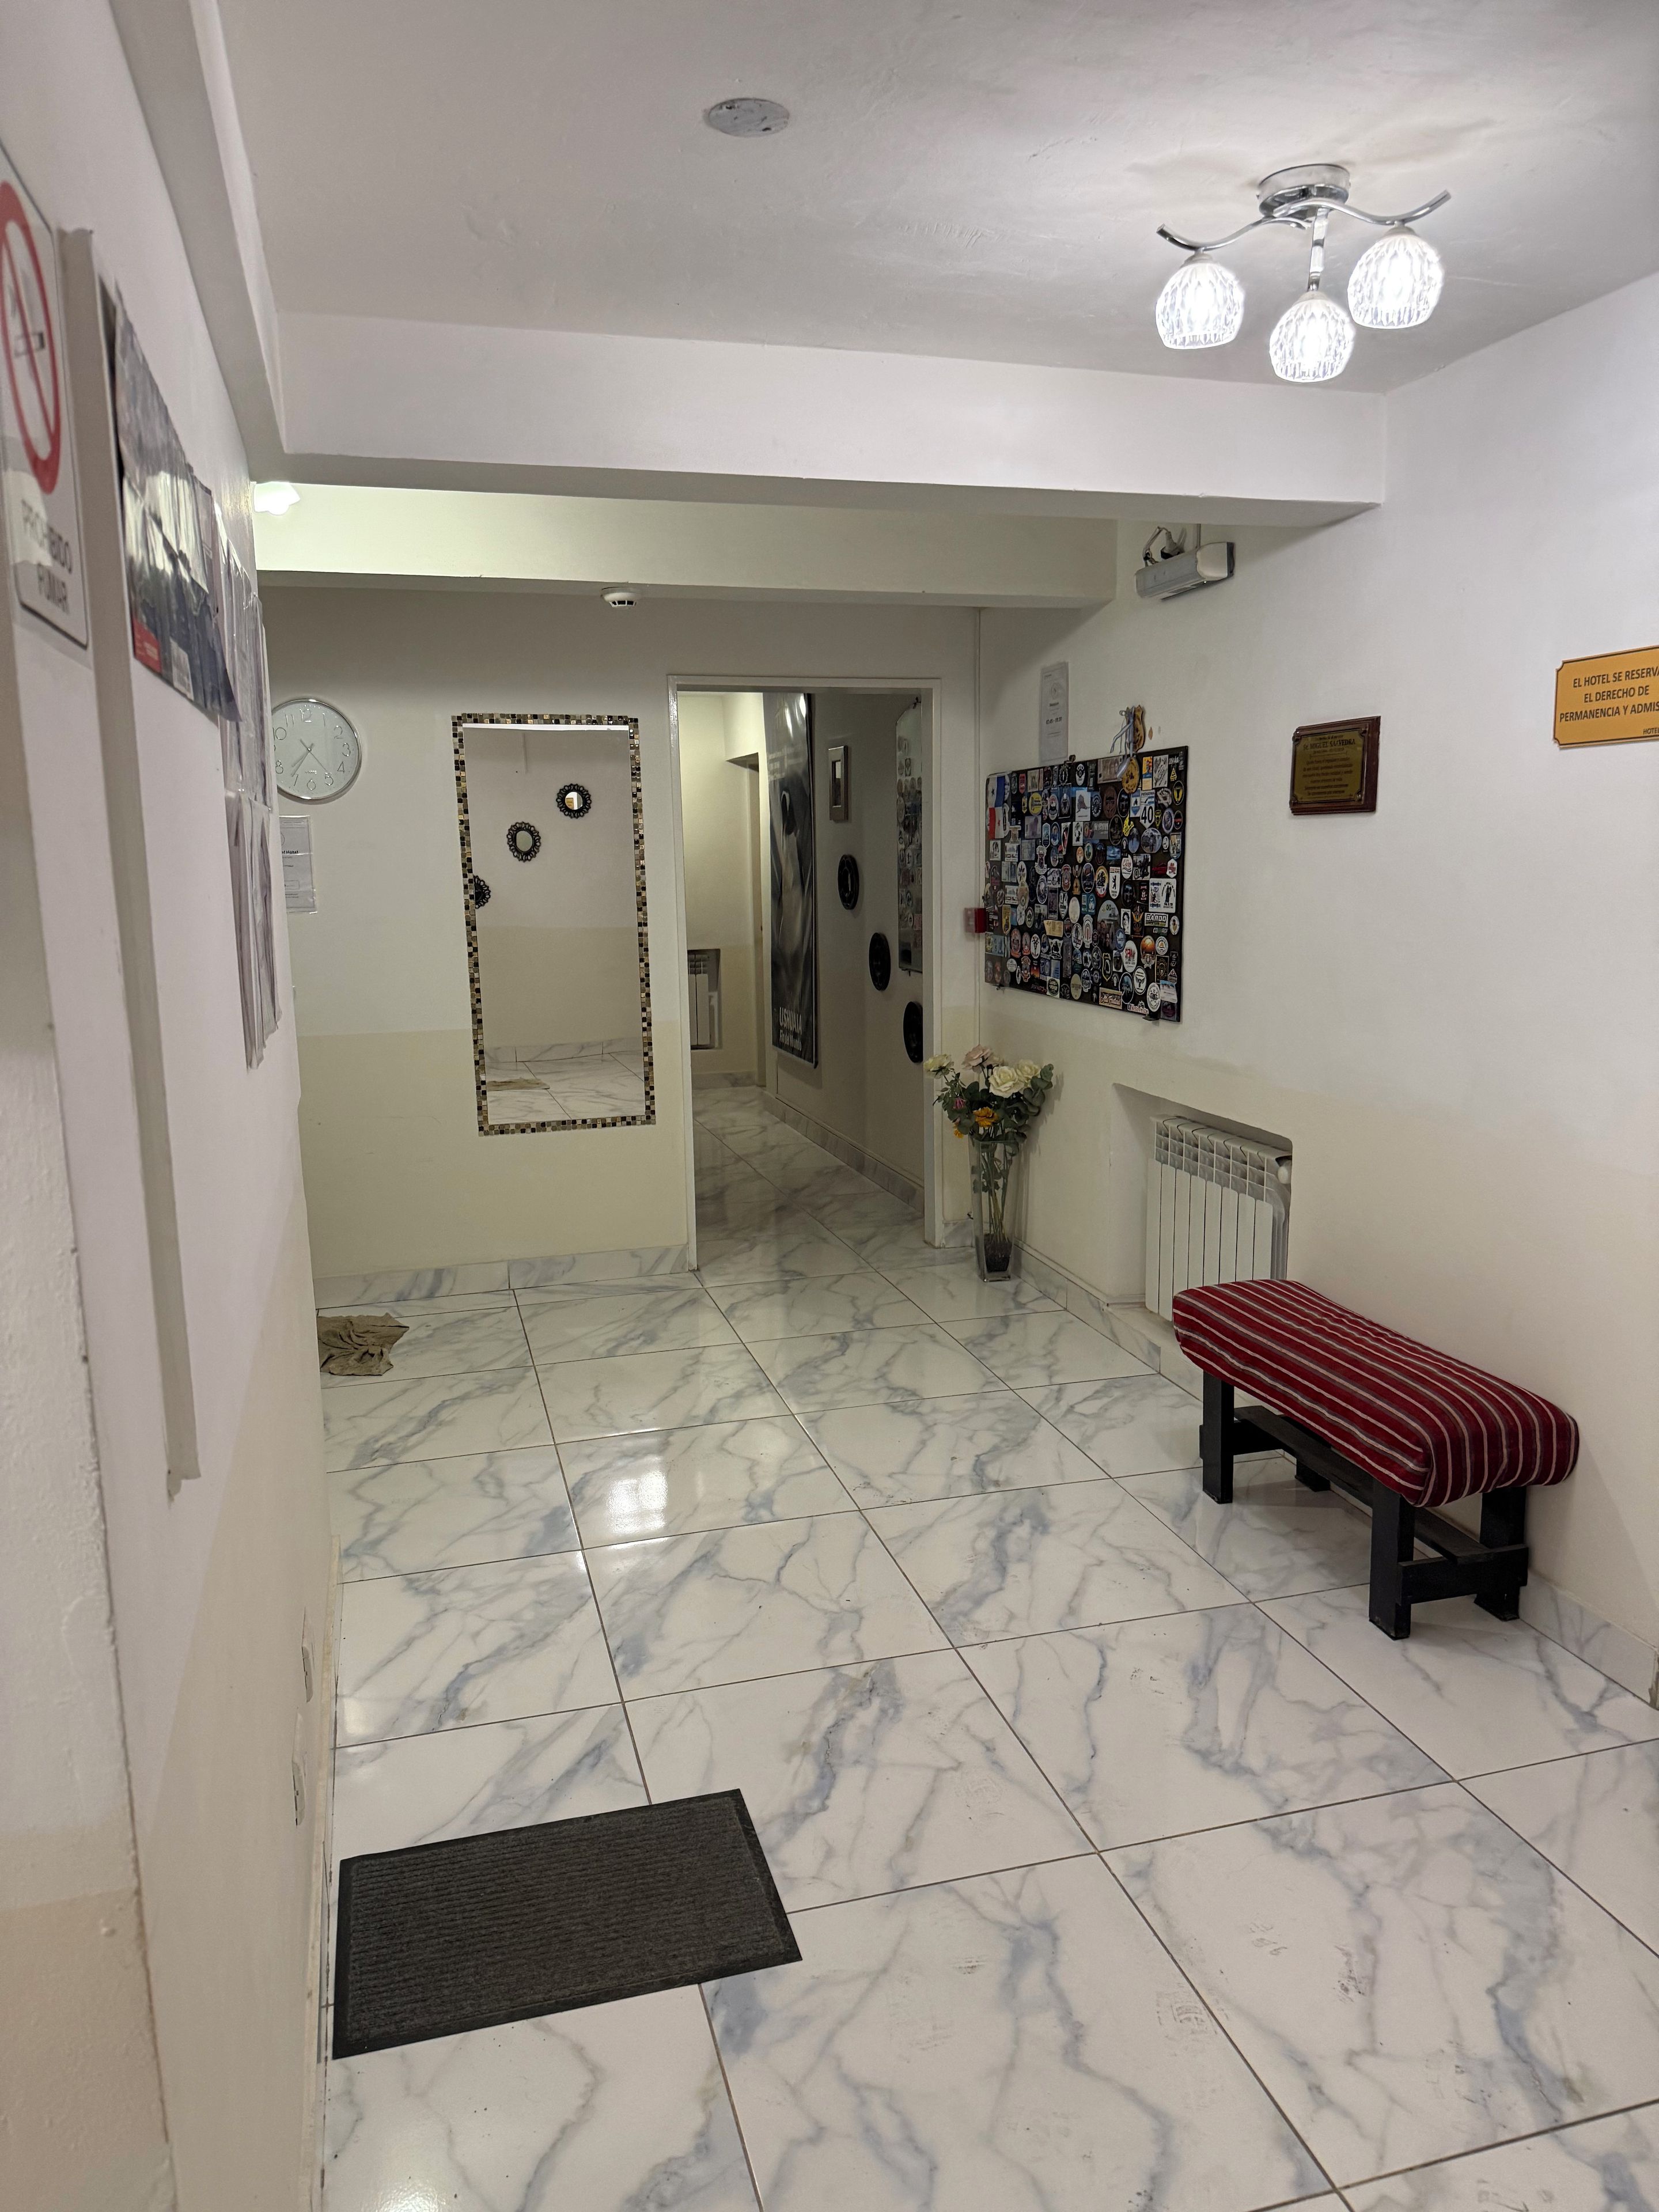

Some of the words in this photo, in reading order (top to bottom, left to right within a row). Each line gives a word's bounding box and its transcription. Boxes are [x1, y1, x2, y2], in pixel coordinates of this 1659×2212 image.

[1573, 678, 1582, 688] EL
[1584, 674, 1610, 686] HOTEL
[1612, 672, 1622, 683] SE
[1584, 693, 1593, 703] EL
[1595, 687, 1635, 701] DERECHO
[1638, 685, 1649, 696] DE
[300, 709, 312, 722] 12
[1560, 706, 1620, 722] PERMANENCIA
[1623, 704, 1629, 715] Y
[286, 714, 294, 727] 11
[272, 727, 286, 740] 10
[334, 725, 343, 739] 2
[342, 743, 351, 757] 3
[275, 760, 283, 774] 8
[337, 761, 345, 773] 4
[324, 772, 334, 786] 5
[1141, 806, 1153, 824] 40
[779, 1007, 802, 1035] USHUAIA
